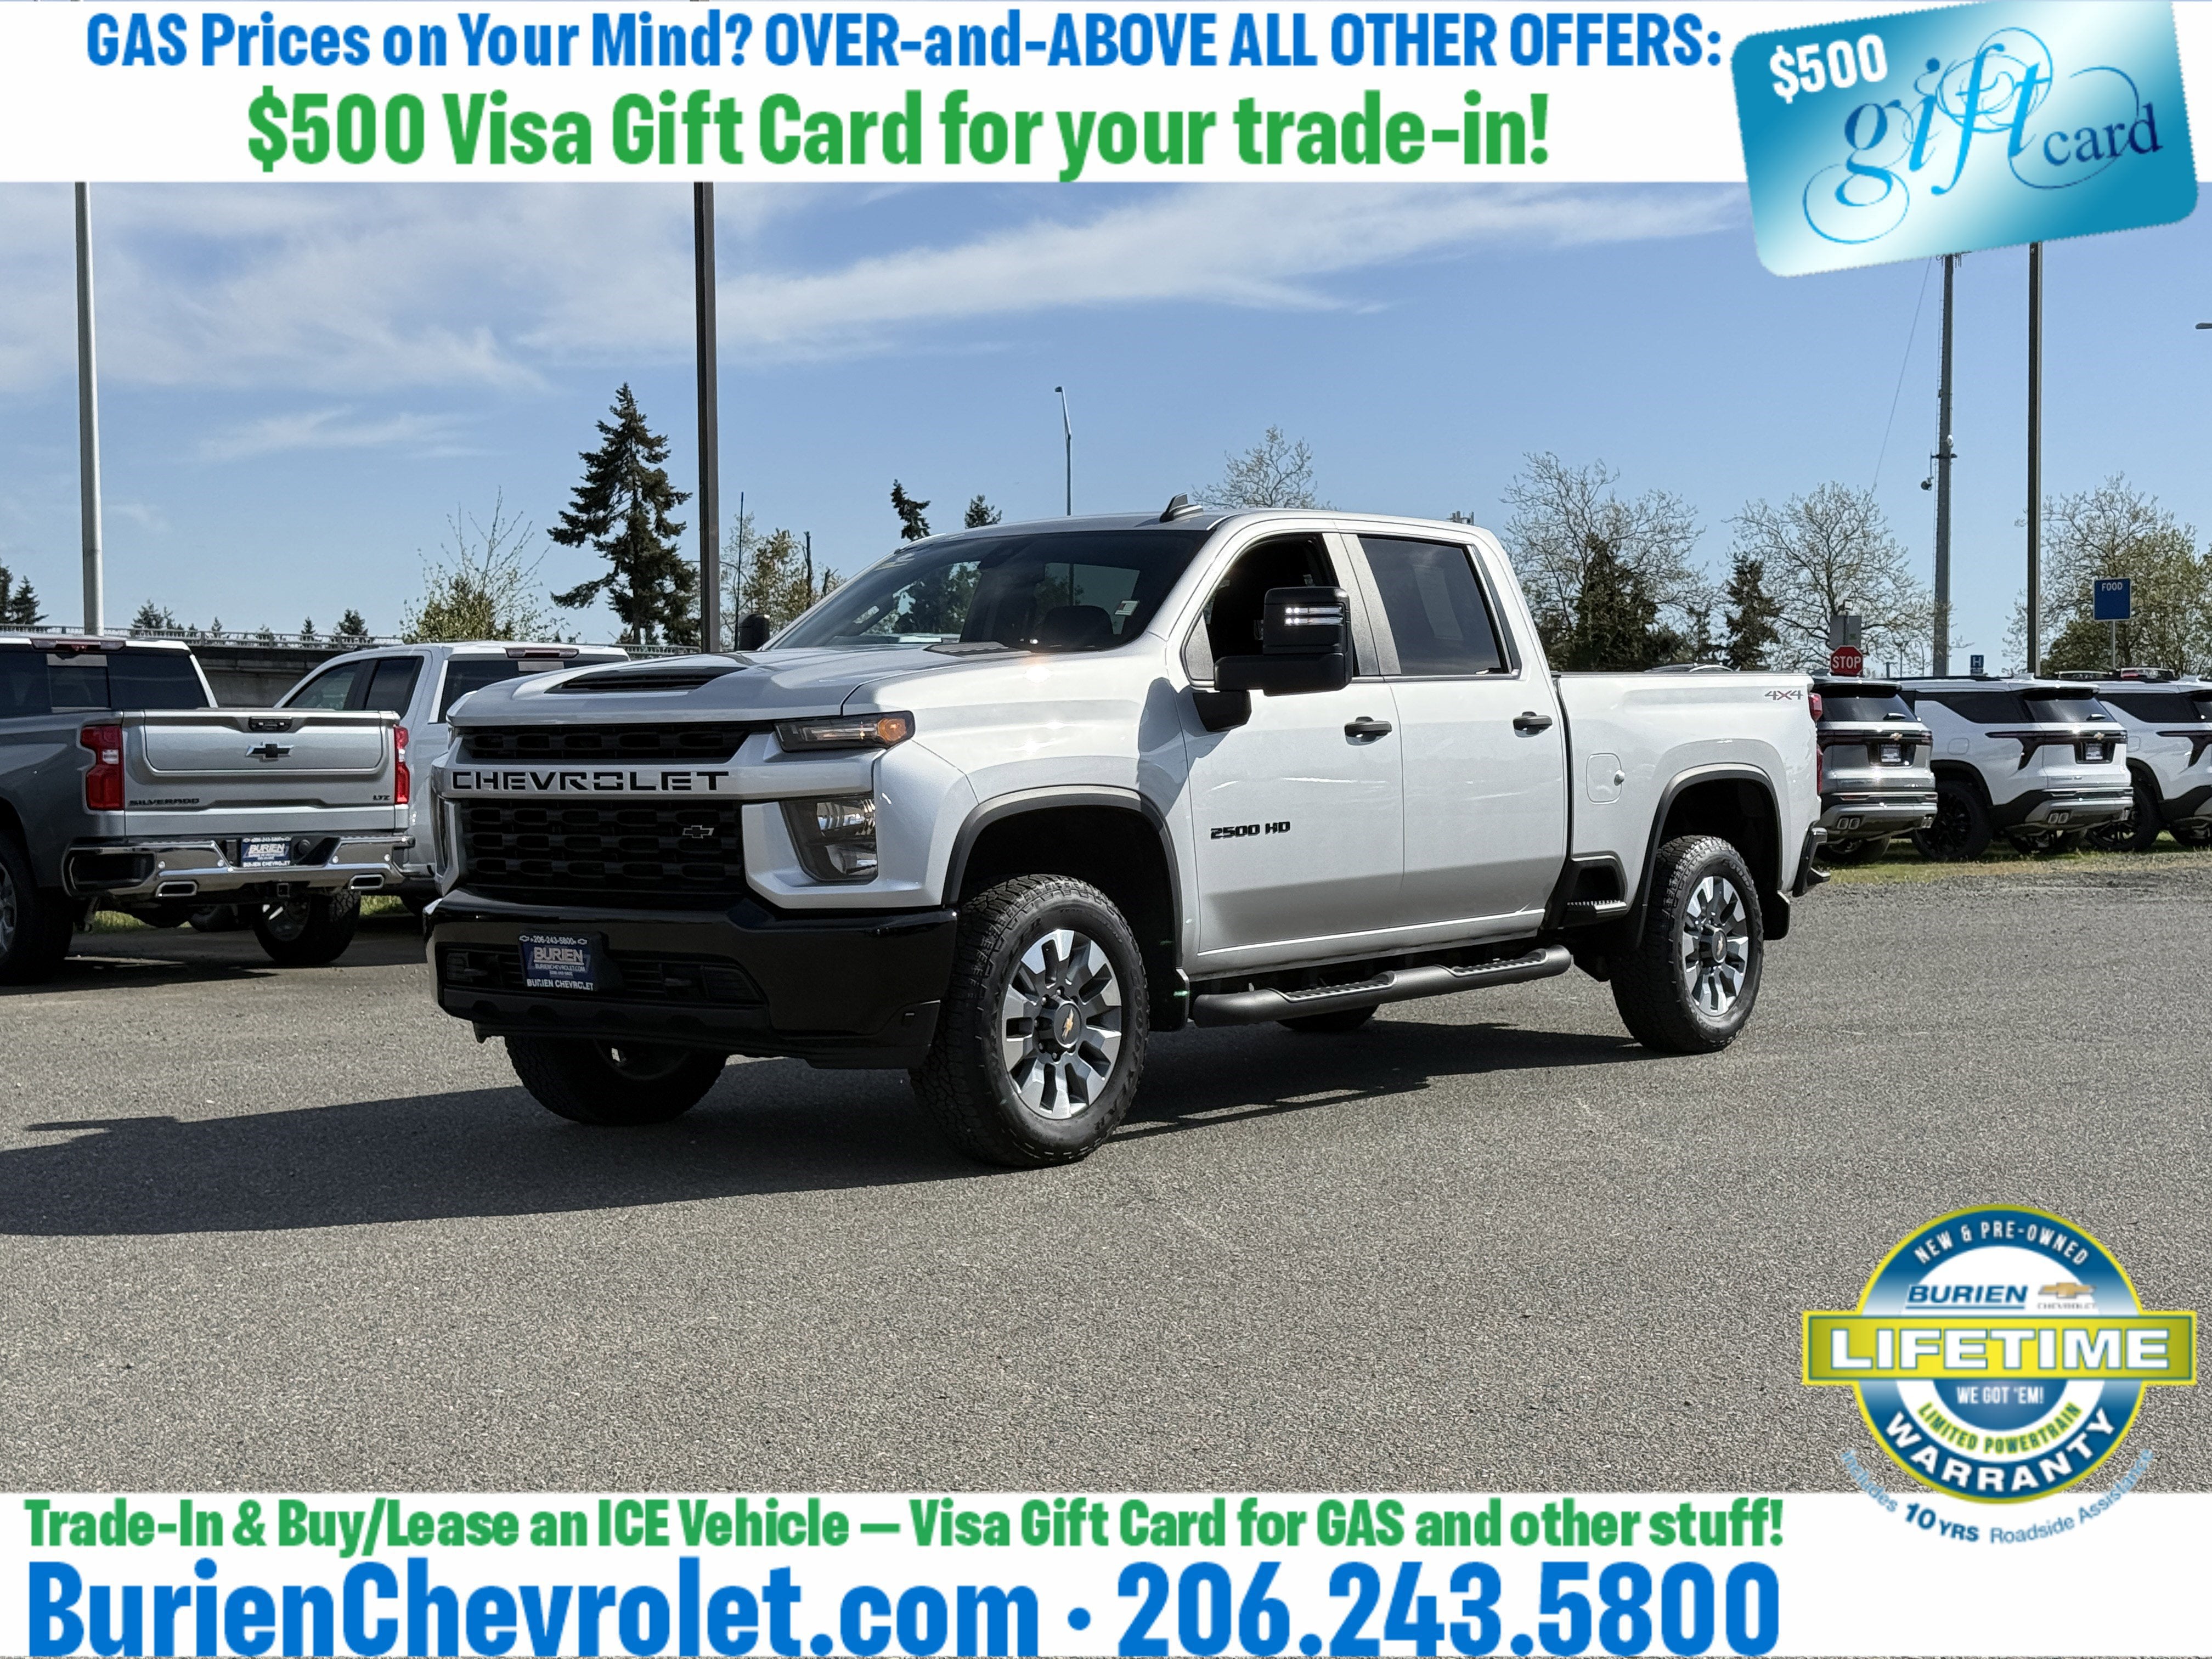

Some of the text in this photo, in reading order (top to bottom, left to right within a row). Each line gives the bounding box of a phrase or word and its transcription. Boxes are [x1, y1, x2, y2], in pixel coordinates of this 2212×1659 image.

[2102, 582, 2123, 591] FOOD
[1832, 656, 1861, 669] STOP
[1973, 657, 1981, 667] H
[452, 771, 729, 791] CHEVROLET
[1211, 821, 1290, 839] 2500 HD
[249, 843, 285, 854] BURIEN
[534, 946, 583, 962] BURIEN
[527, 979, 594, 990] BURIEN CHEVROLET
